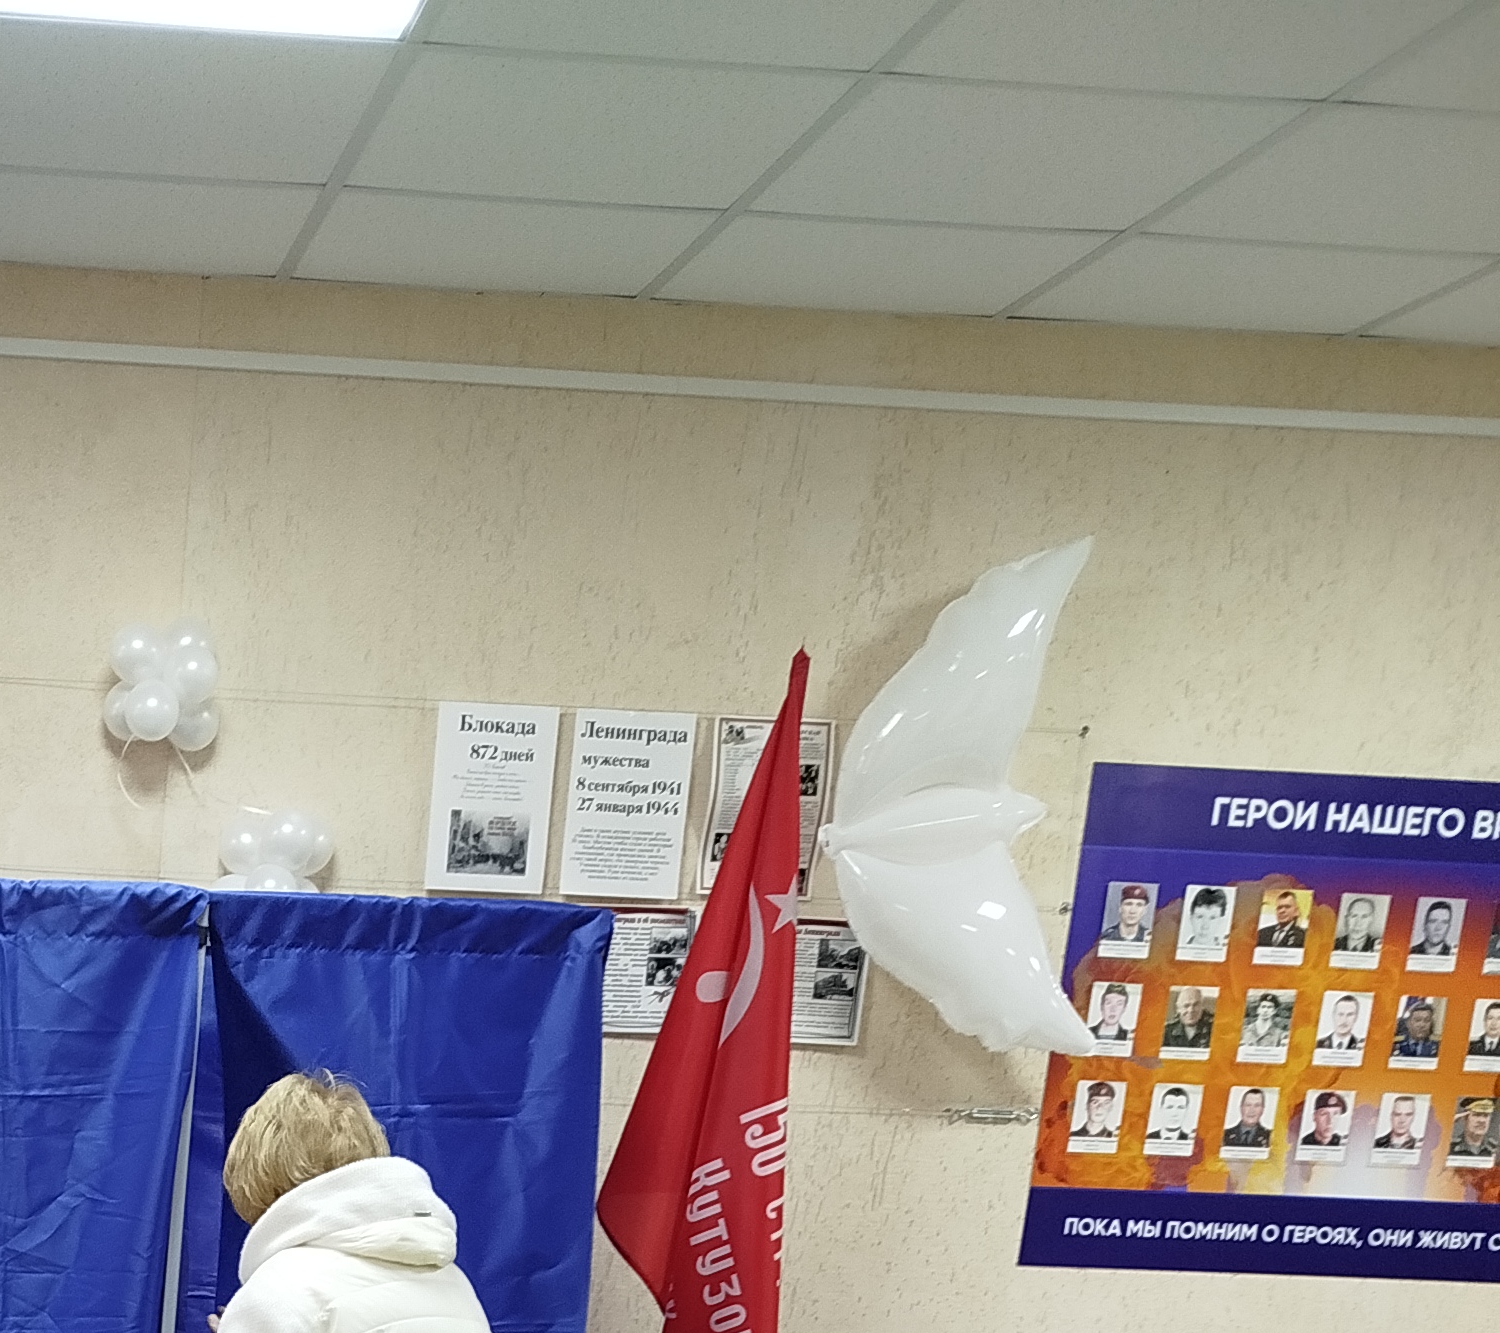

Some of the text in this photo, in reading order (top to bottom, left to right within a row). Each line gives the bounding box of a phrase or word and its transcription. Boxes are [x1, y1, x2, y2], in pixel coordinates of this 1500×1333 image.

[460, 714, 537, 737] Блокада
[581, 721, 688, 746] Ленинграда
[469, 744, 535, 763] 872 дней
[581, 755, 650, 769] мужества
[576, 777, 682, 797] 8 сентября 1941
[577, 797, 679, 817] 27 января 1944
[1211, 797, 1319, 831] ГЕРОИ
[1324, 802, 1466, 838] НАШЕГО
[1063, 1217, 1123, 1237] ПОКА
[1125, 1219, 1163, 1238] МЫ
[1164, 1221, 1260, 1242] ПОМНИМ
[1261, 1224, 1280, 1243] О
[1282, 1225, 1364, 1249] ГЕРОЯХ,
[1367, 1228, 1415, 1248] ОНИ
[1414, 1230, 1487, 1251] ЖИВУТ
